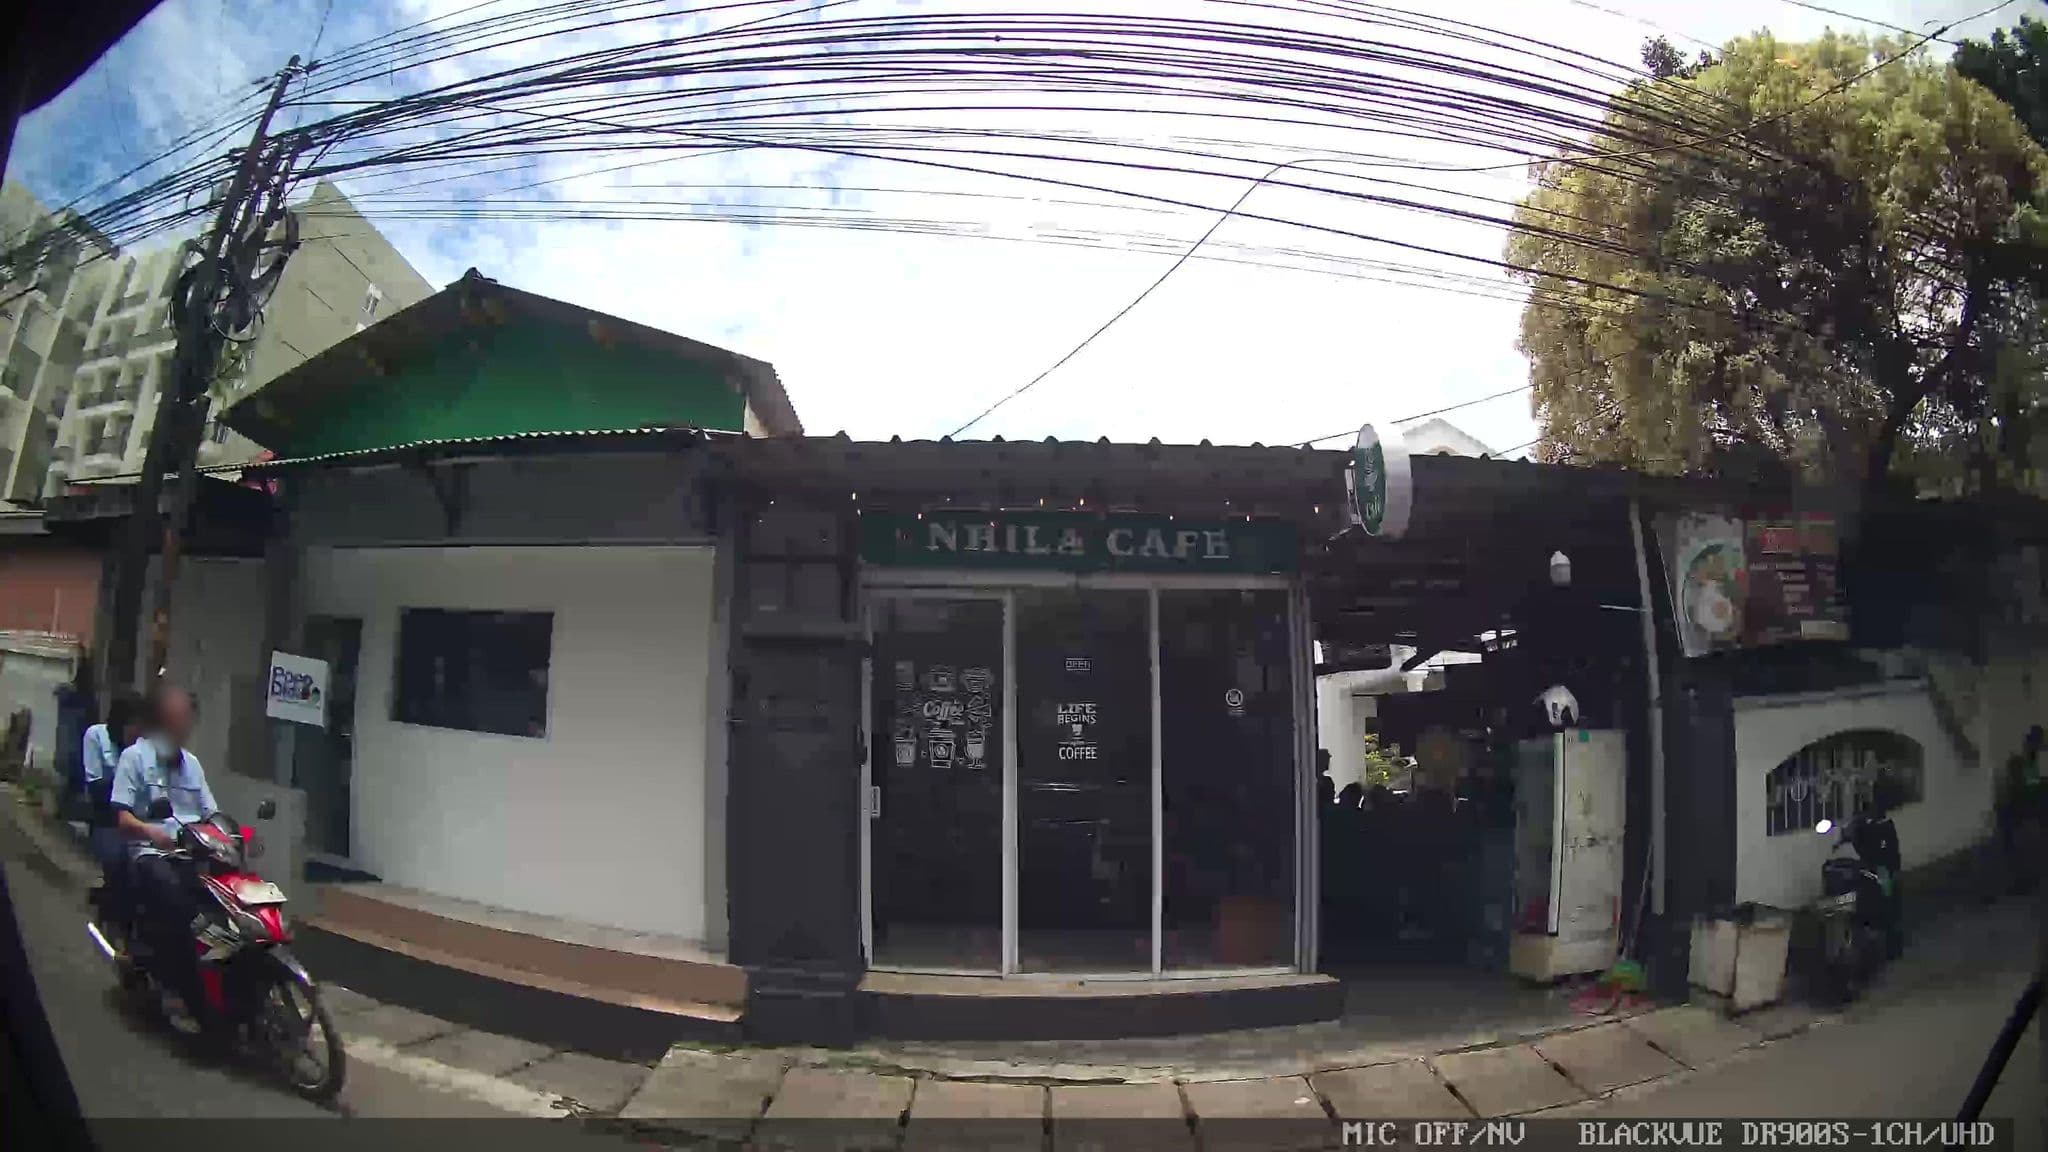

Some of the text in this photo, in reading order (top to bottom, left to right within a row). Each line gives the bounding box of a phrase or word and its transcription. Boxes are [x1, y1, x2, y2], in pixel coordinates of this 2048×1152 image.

[926, 522, 1085, 555] NHILA
[1057, 703, 1097, 714] LIFE
[1057, 714, 1097, 724] BEGINS
[1058, 746, 1097, 760] COFFEE
